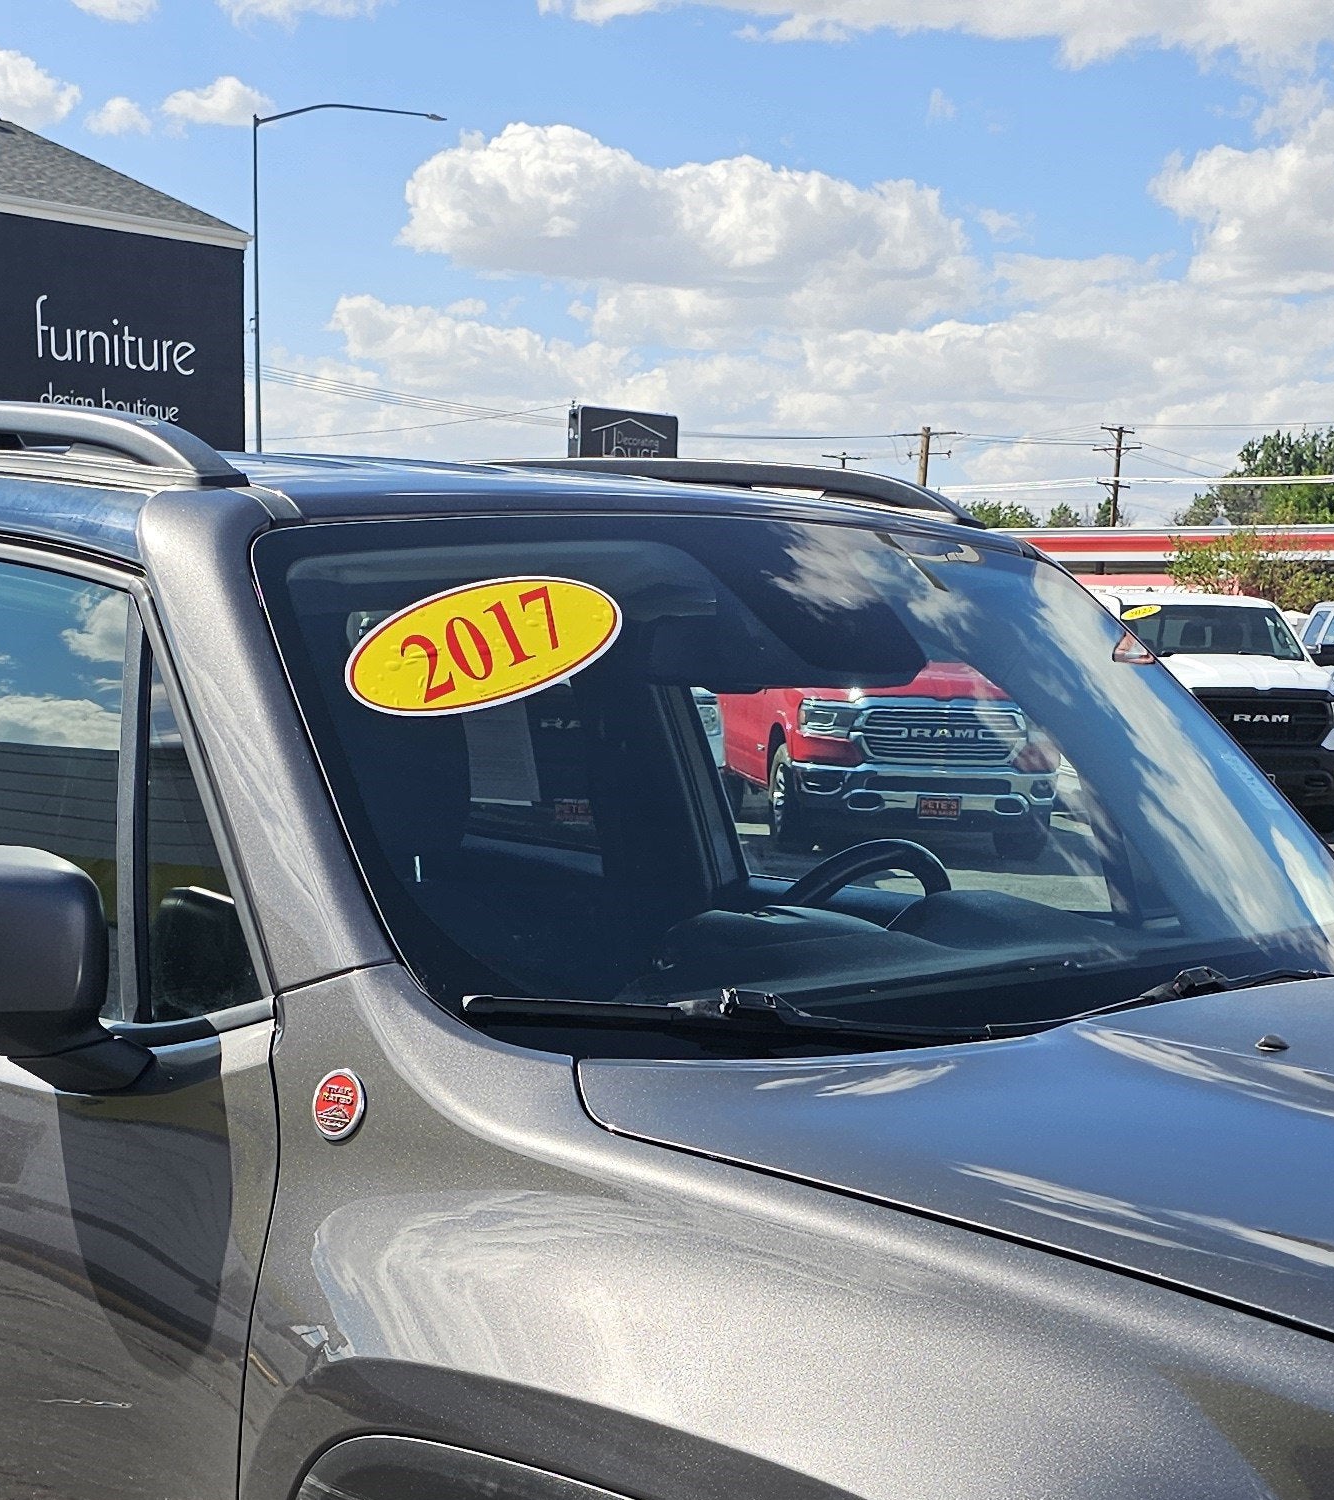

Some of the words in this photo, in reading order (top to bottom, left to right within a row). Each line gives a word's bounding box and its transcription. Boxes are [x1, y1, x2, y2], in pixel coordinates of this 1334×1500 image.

[35, 294, 196, 376] furniture
[101, 387, 179, 422] boutique
[617, 430, 660, 451] Decorating
[400, 585, 560, 704] 2017
[1233, 713, 1290, 723] RAM
[910, 728, 976, 739] RAM
[920, 800, 957, 810] PETE'S
